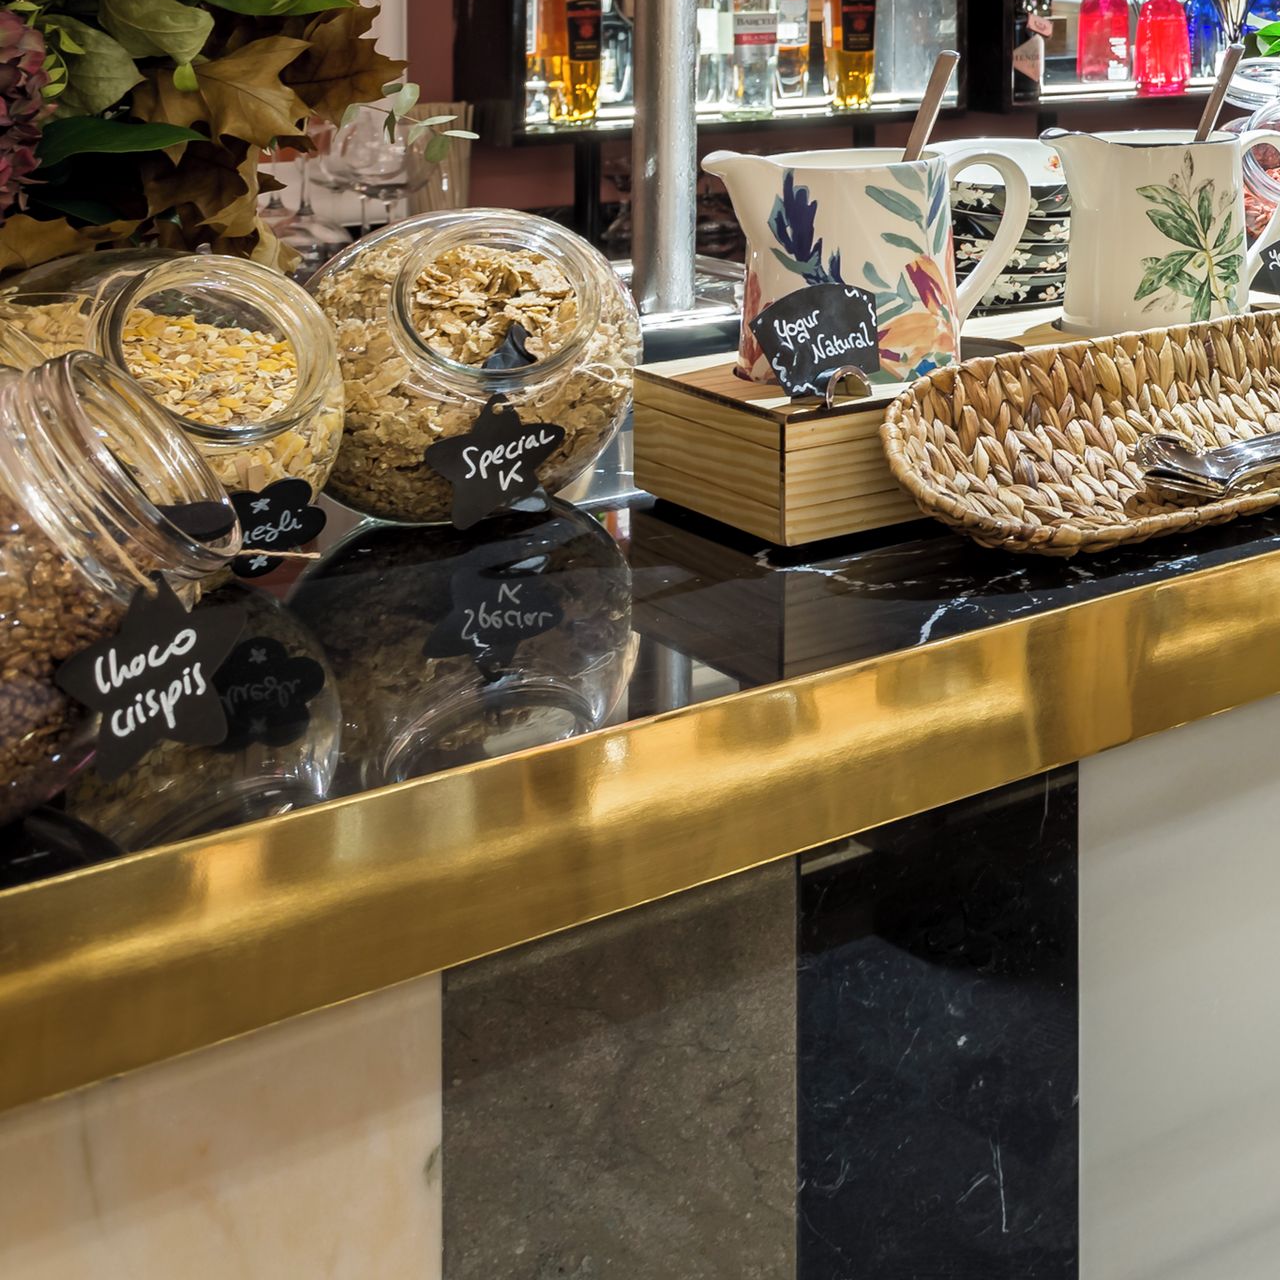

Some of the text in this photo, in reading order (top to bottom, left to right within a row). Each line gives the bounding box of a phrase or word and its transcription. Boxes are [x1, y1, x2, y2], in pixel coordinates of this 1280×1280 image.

[773, 309, 821, 351] Yogur
[811, 321, 875, 364] Natural
[462, 429, 555, 479] Special
[498, 460, 524, 491] K
[95, 628, 197, 694] Choco
